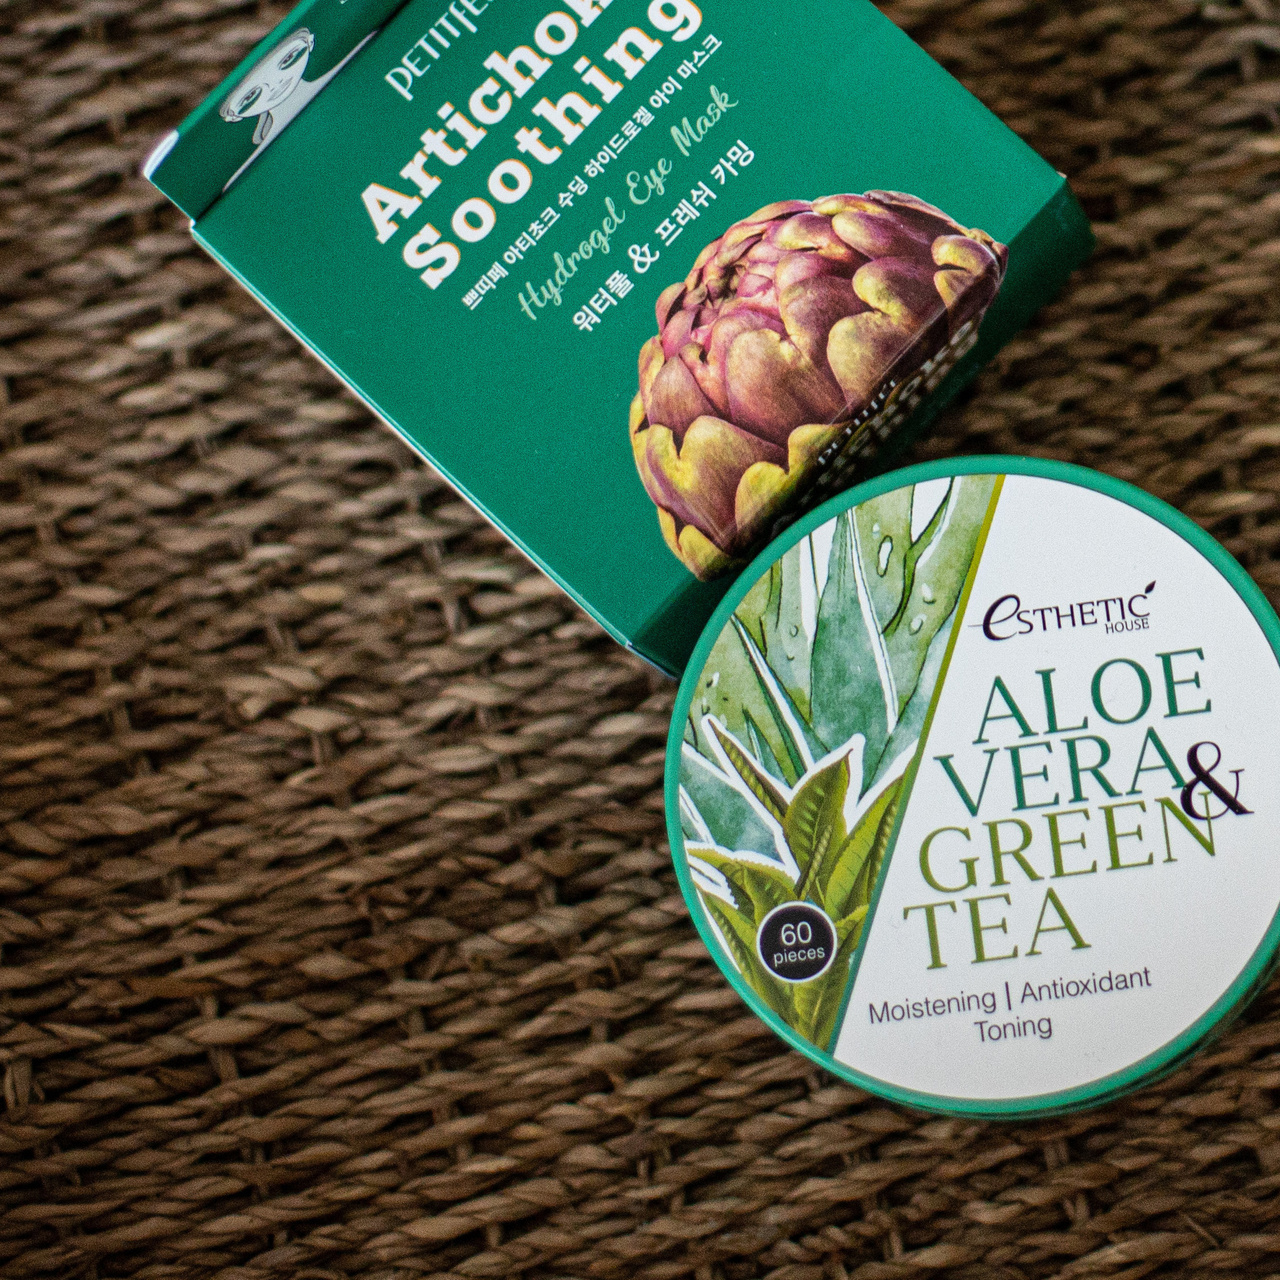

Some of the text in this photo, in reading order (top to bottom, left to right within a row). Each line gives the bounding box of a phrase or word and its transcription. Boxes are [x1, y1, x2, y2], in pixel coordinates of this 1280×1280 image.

[461, 33, 723, 311] 쁘띠페 아티초크 수딩 하이드로겔 아이 마스크
[517, 84, 739, 321] Hydrogel Eye Mask
[627, 243, 660, 274] &
[655, 180, 718, 247] 프레쉬
[709, 138, 756, 186] 카밍
[1104, 617, 1150, 635] HOUSE
[972, 647, 1212, 745] ALOE
[933, 726, 1255, 820] VERA &
[917, 791, 1217, 894] GREEN
[773, 943, 826, 969] pieces
[780, 921, 812, 946] 60
[903, 886, 1092, 971] TEA
[868, 988, 997, 1025] Moistening
[1020, 966, 1152, 1006] Antioxidant
[973, 1014, 1053, 1045] Toning
